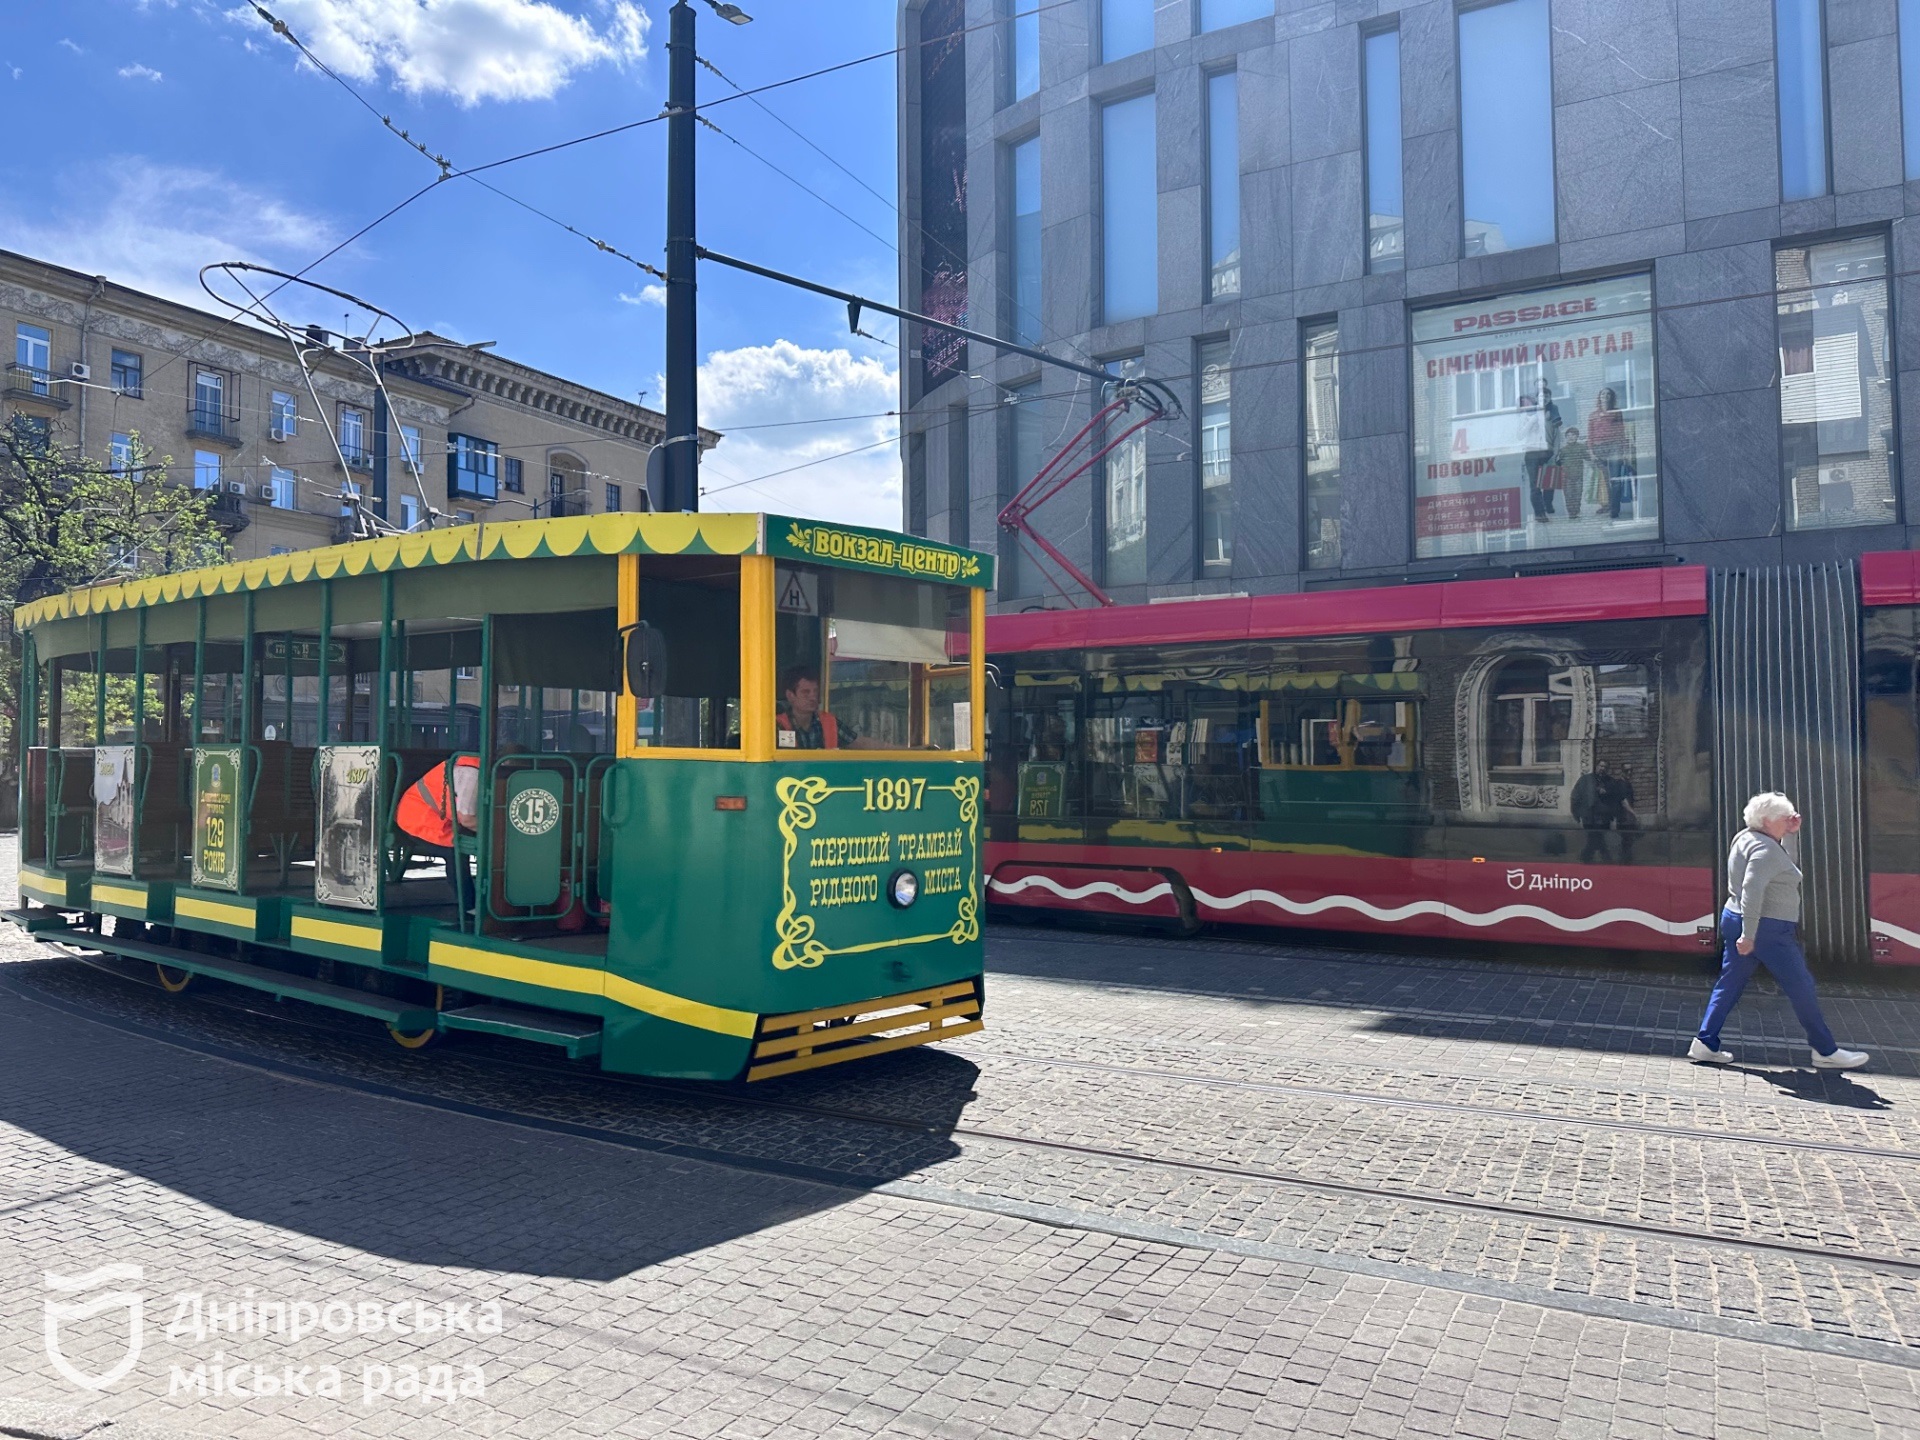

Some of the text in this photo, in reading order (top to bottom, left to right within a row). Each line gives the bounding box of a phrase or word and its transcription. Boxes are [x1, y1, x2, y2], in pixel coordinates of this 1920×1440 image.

[1453, 297, 1597, 333] PASSAGE
[1426, 331, 1634, 379] СІМЕЙНИЙ КВАРТАЛ
[1452, 428, 1470, 454] 4
[1485, 492, 1509, 503] світ
[863, 778, 926, 811] 1897
[525, 798, 544, 824] 15
[206, 816, 225, 848] 129
[810, 827, 963, 867] ПЕРШИЙ ТРАМВАЙ
[203, 849, 226, 874] РОКІВ
[810, 867, 962, 908] РІДНОГО МІСТА
[1528, 873, 1593, 892] Дніпро
